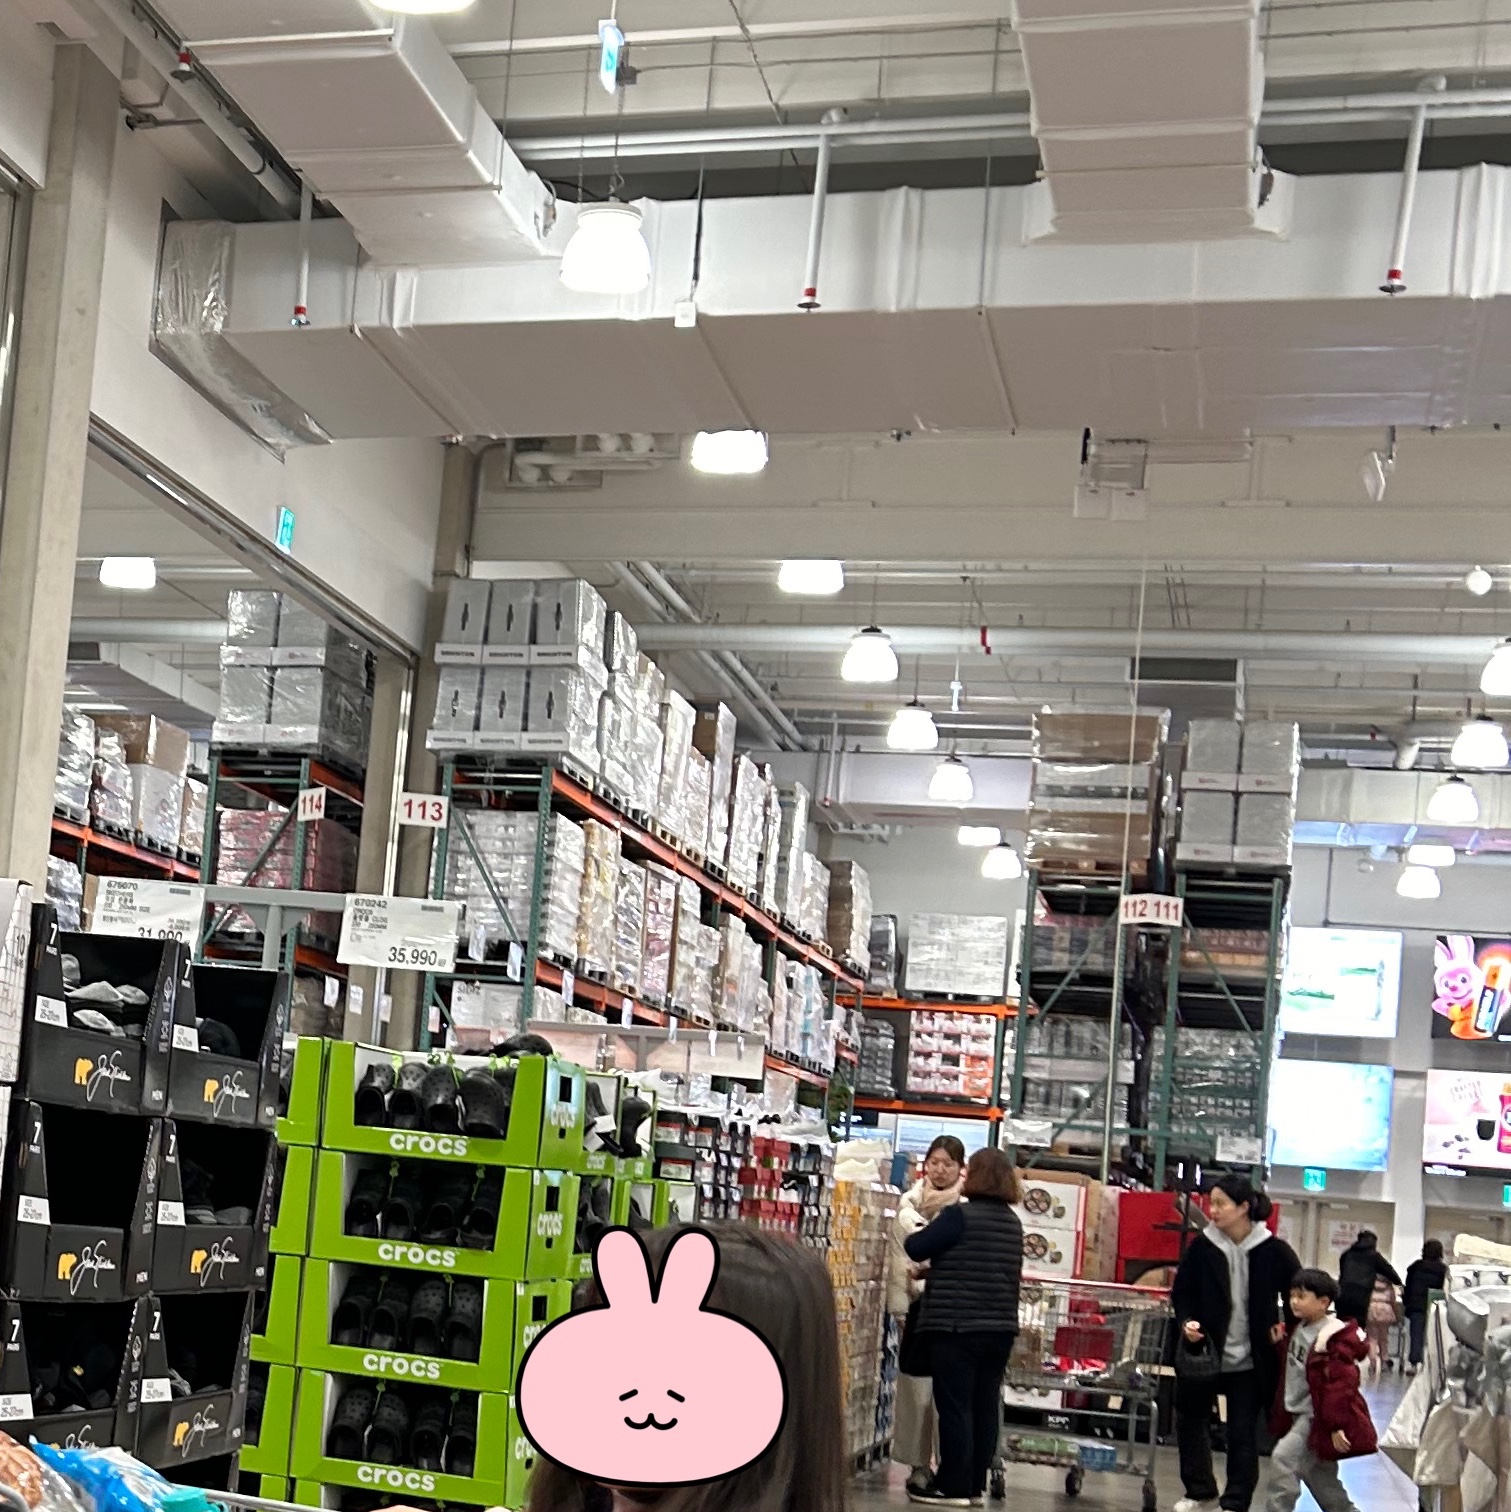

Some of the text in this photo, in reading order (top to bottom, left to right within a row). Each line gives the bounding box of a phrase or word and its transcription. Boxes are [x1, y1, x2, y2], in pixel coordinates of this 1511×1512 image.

[301, 794, 322, 815] 114
[403, 799, 443, 822] 113
[354, 898, 388, 909] 670242
[1124, 899, 1179, 921] 112 111
[50, 922, 58, 945] 7
[388, 946, 438, 966] 35,990
[184, 958, 191, 979] 7
[33, 1121, 41, 1144] 7
[169, 1134, 176, 1155] 7
[389, 1133, 467, 1156] crocs
[377, 1243, 456, 1268] crocs
[10, 1318, 20, 1342] 7
[152, 1311, 161, 1332] 7
[362, 1353, 440, 1380] crocs
[357, 1465, 435, 1492] crocs
